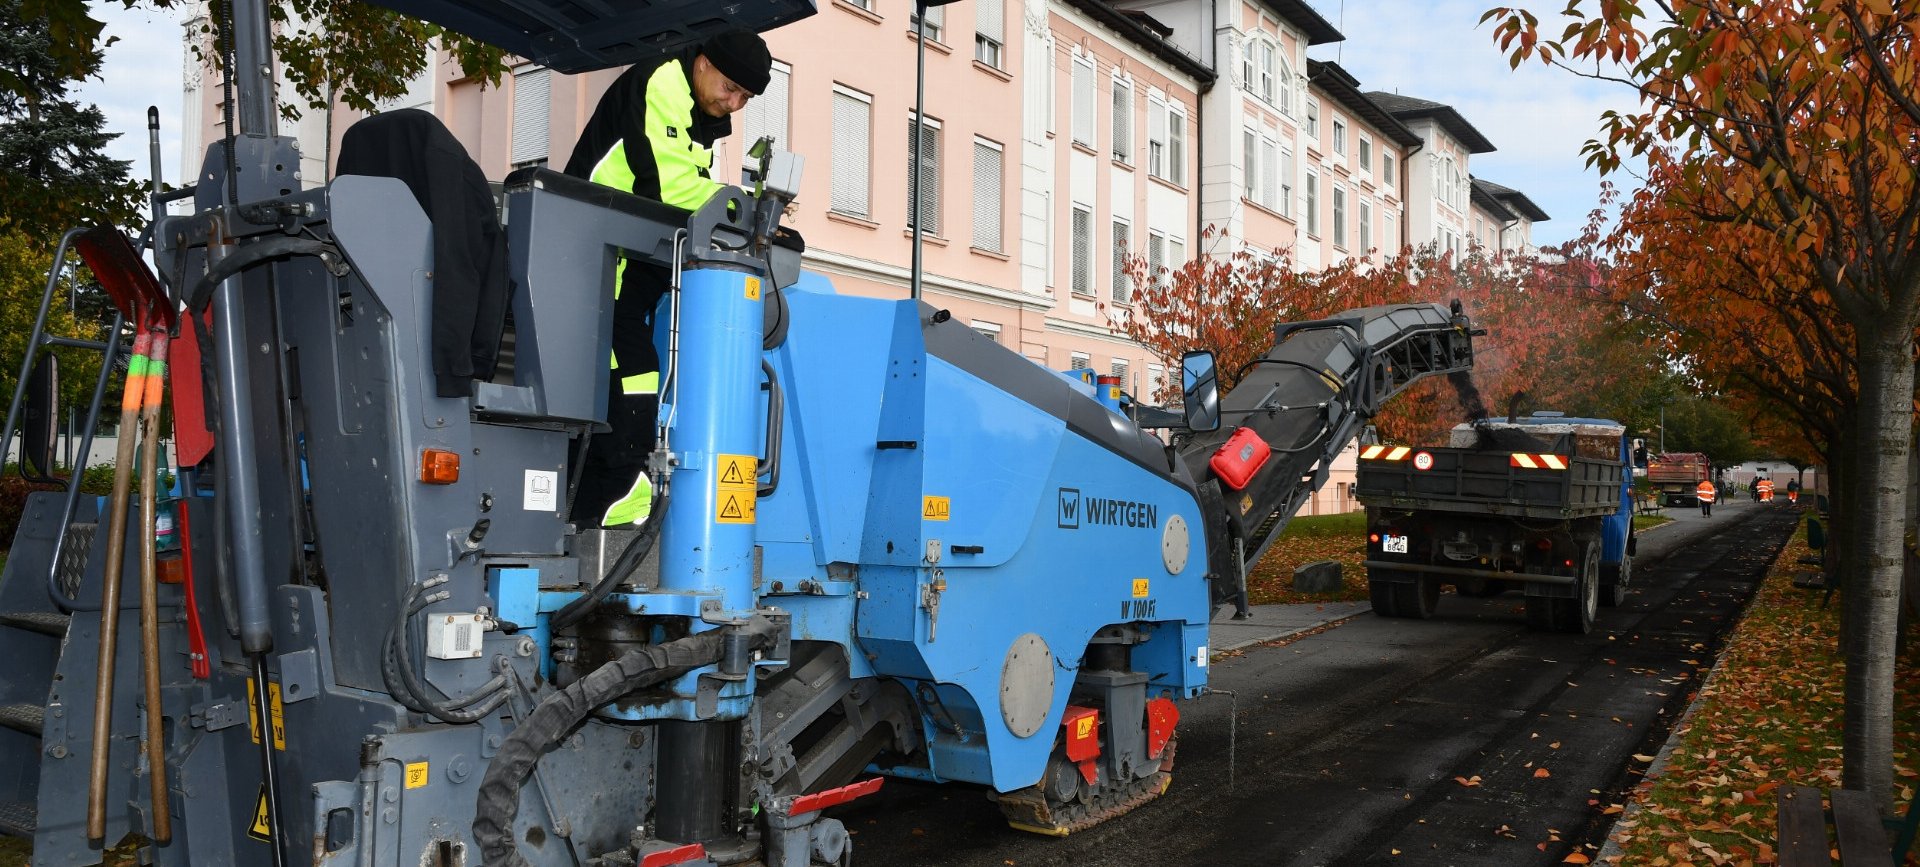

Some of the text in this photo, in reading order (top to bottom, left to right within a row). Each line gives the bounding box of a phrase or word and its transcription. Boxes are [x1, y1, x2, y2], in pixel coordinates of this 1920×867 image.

[1418, 455, 1428, 463] 80
[1085, 497, 1157, 529] WIRTGEN
[1121, 598, 1156, 620] W 100Fi
